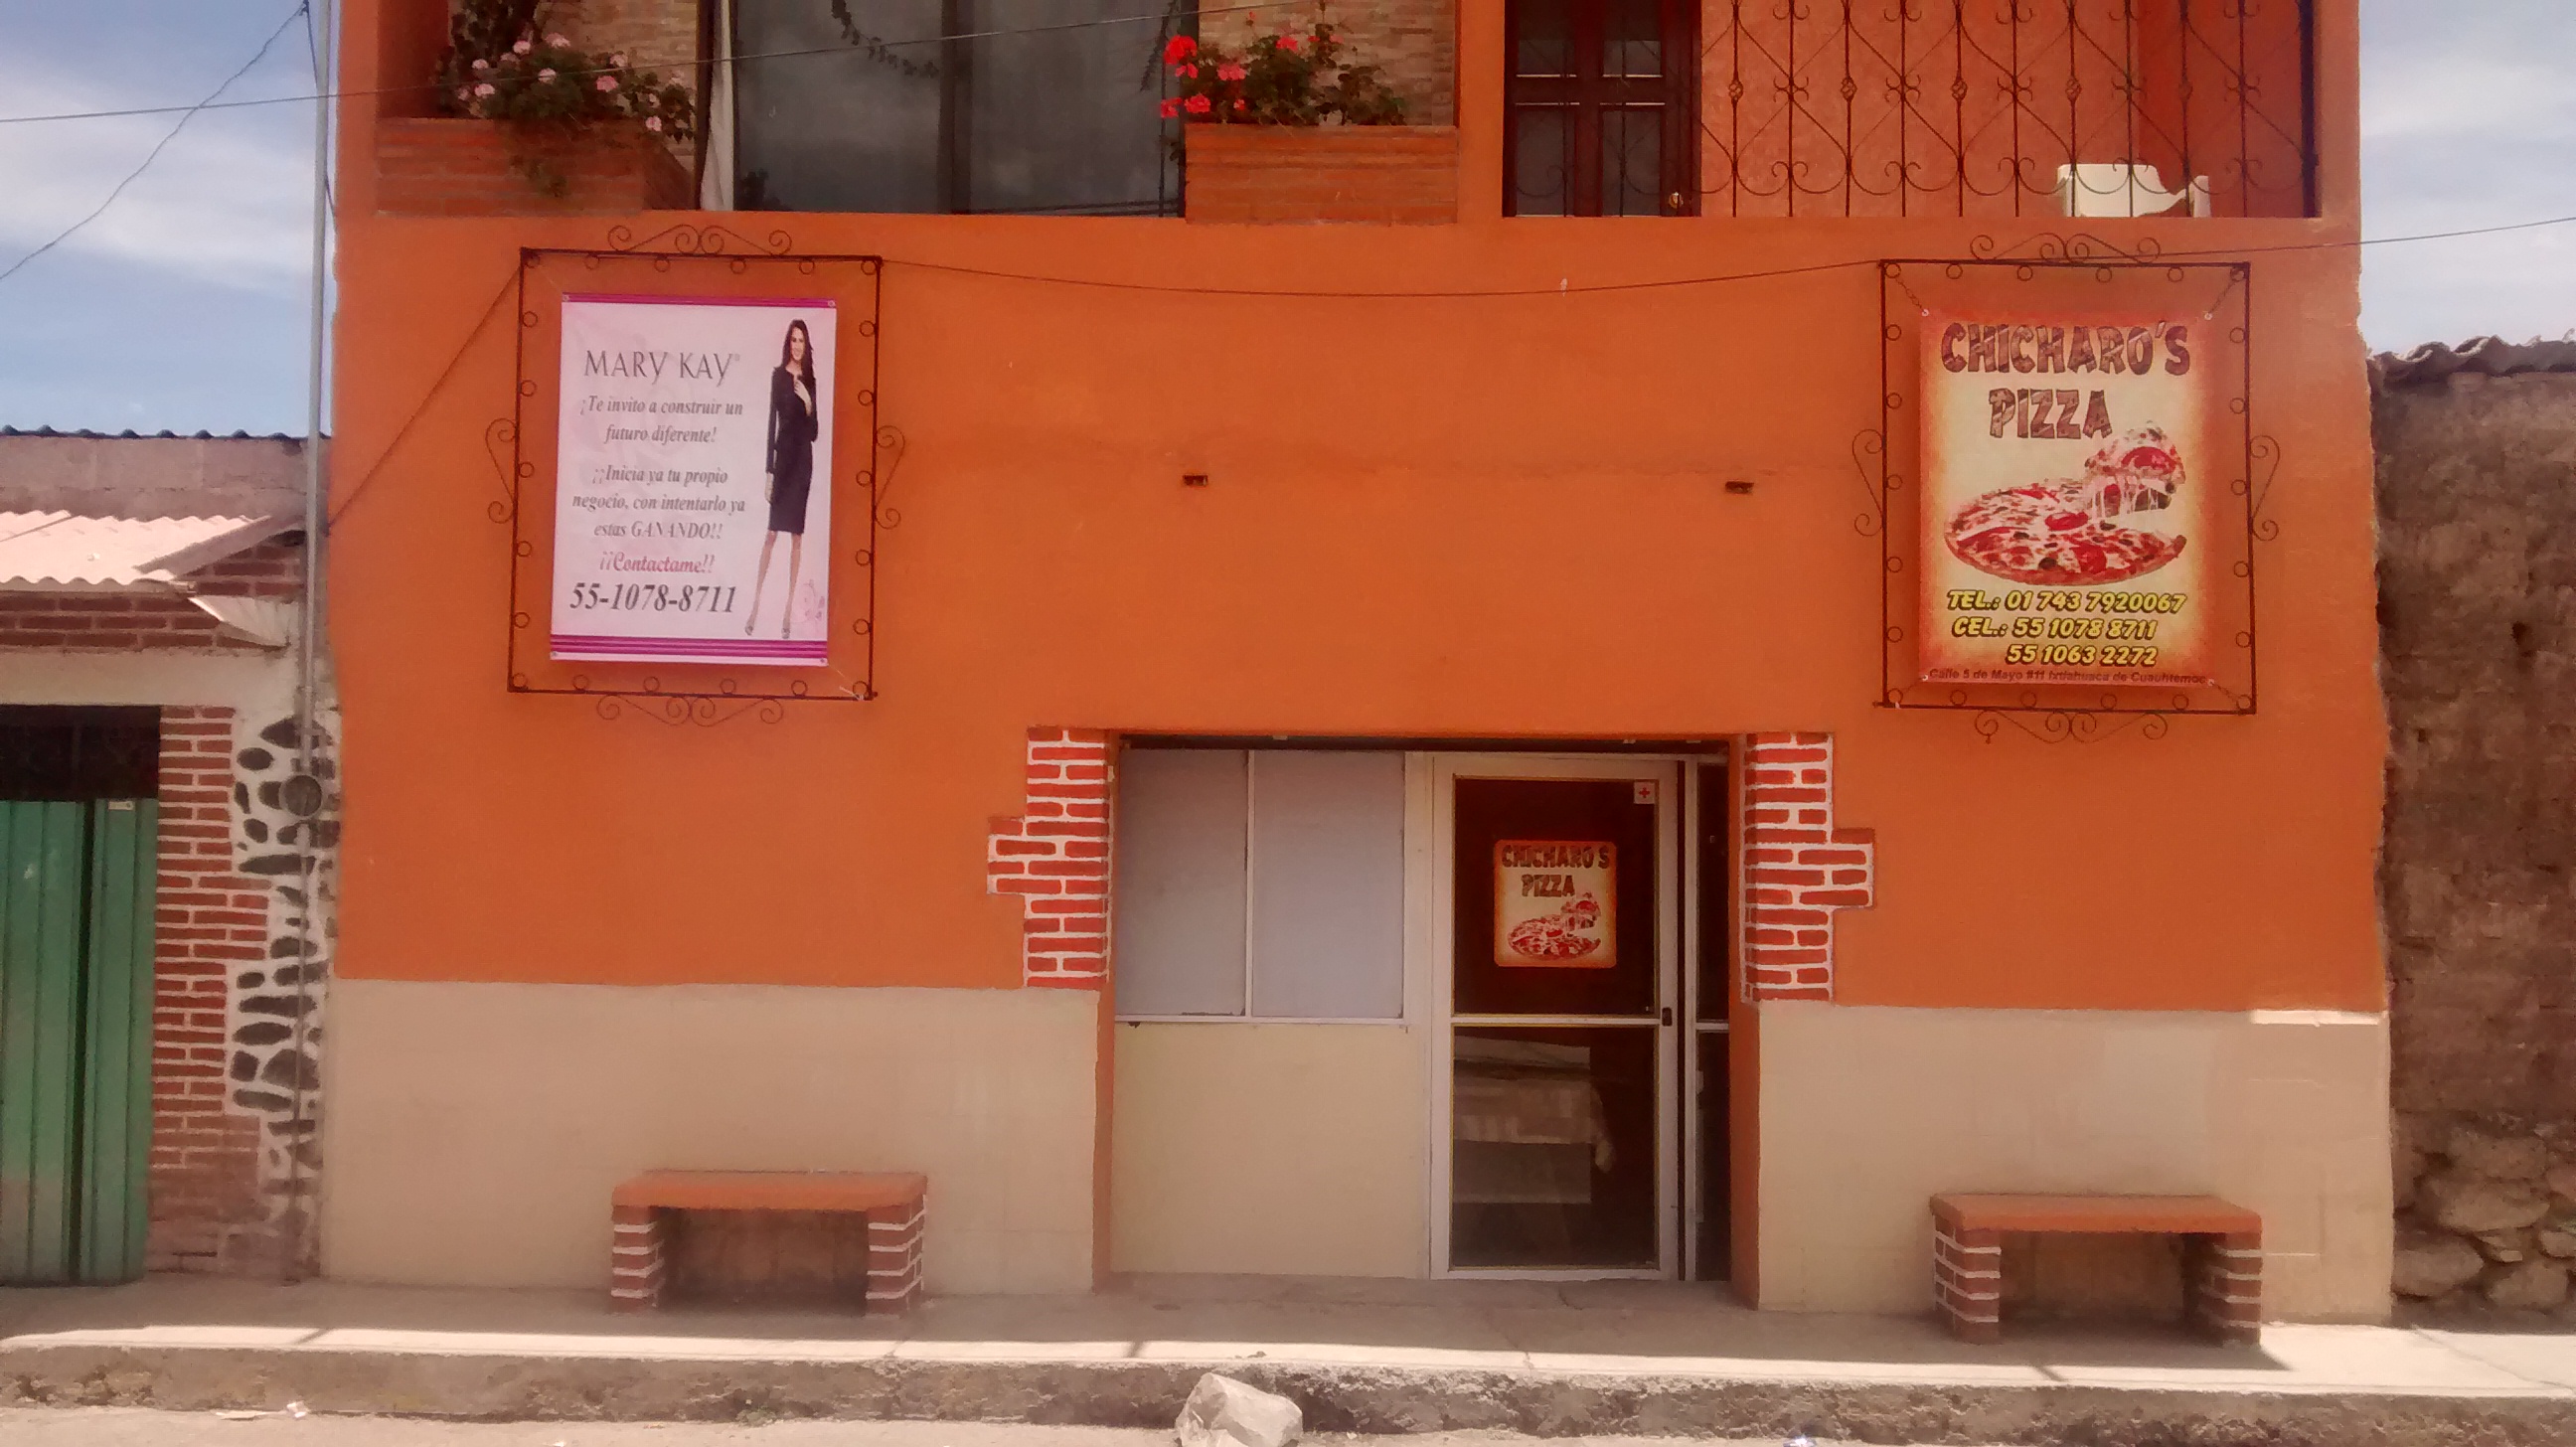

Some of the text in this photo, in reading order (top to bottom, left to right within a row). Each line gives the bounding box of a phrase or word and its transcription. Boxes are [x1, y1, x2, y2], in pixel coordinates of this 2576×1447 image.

[1941, 321, 2190, 377] CHICHARO'S
[584, 350, 668, 385] MARY
[580, 396, 743, 415] ¡Te invito a construir un
[1989, 388, 2113, 439] PIZZA
[604, 425, 717, 445] futuro diferente!
[646, 471, 664, 487] ya
[668, 469, 681, 481] tu
[684, 469, 727, 487] propio
[632, 498, 658, 509] con
[661, 495, 726, 512] intentarlo
[727, 501, 745, 516] ya
[594, 521, 724, 540] estas GANANDO!!
[599, 551, 716, 573] ¡¡Contactame!!
[569, 582, 737, 613] 55-1078-8711
[1947, 589, 2186, 614] TEL.: 01 743 7920067
[1952, 616, 2158, 641] CEL.: 55 1078 8711
[2006, 644, 2158, 668] 55 1063 2272
[1929, 668, 1960, 680] Calle
[1963, 670, 1970, 679] 5
[1973, 670, 1988, 680] de
[1992, 670, 2023, 682] Mayo
[2026, 670, 2045, 681] #11
[2113, 672, 2128, 682] de
[1522, 875, 1575, 897] PIZZA
